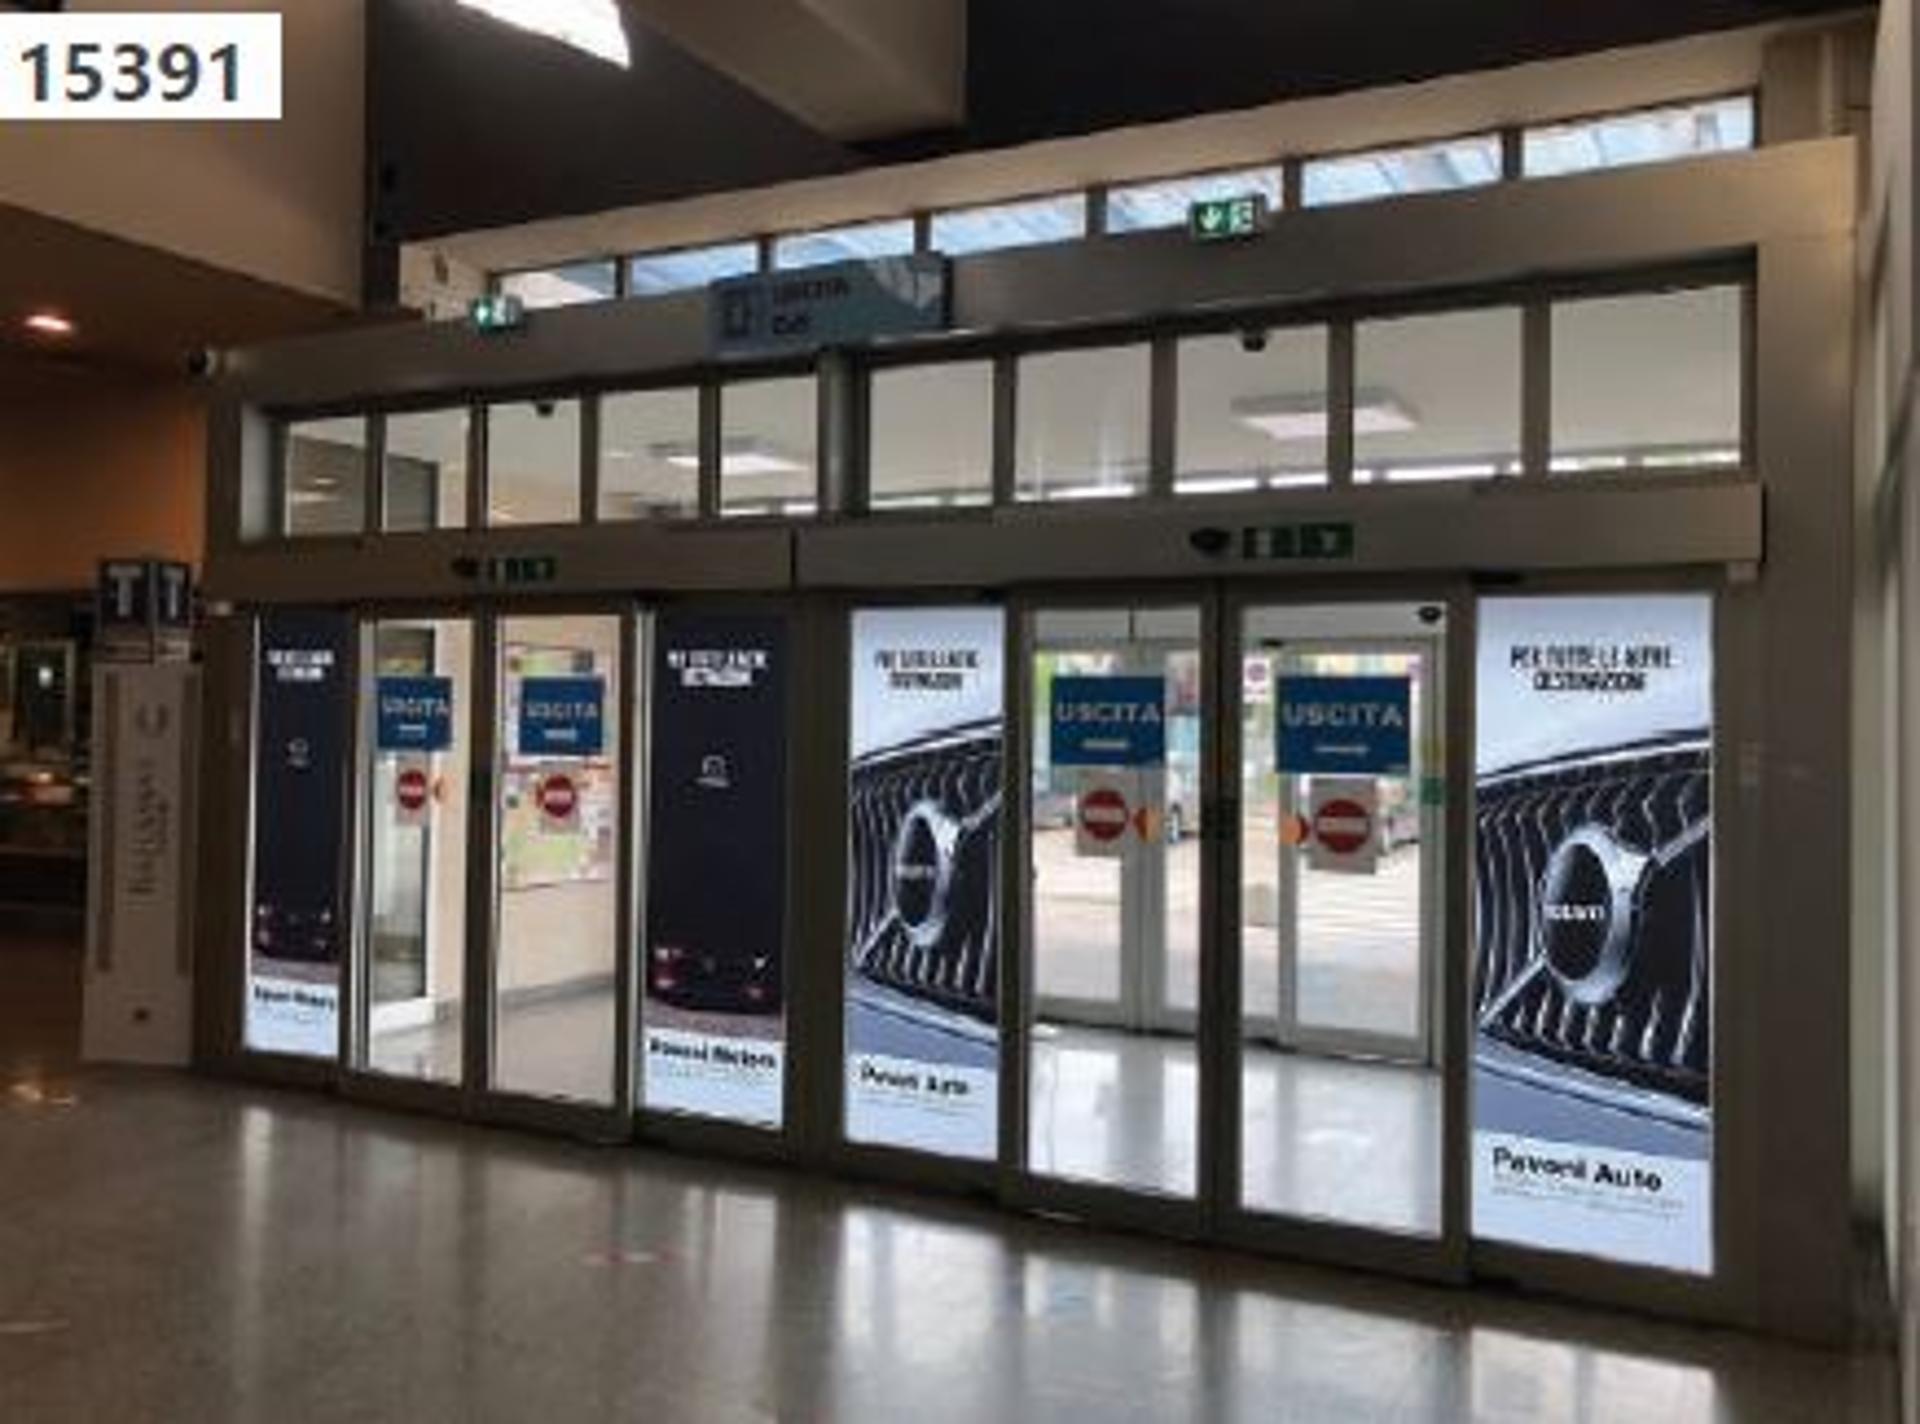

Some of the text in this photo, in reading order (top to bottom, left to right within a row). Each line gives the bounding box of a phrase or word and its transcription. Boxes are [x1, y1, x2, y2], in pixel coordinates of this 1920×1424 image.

[526, 702, 597, 720] USCITA
[1057, 701, 1160, 723] USCITA
[1284, 702, 1403, 727] USCITA
[1493, 1146, 1662, 1192] Pavoni Auto
